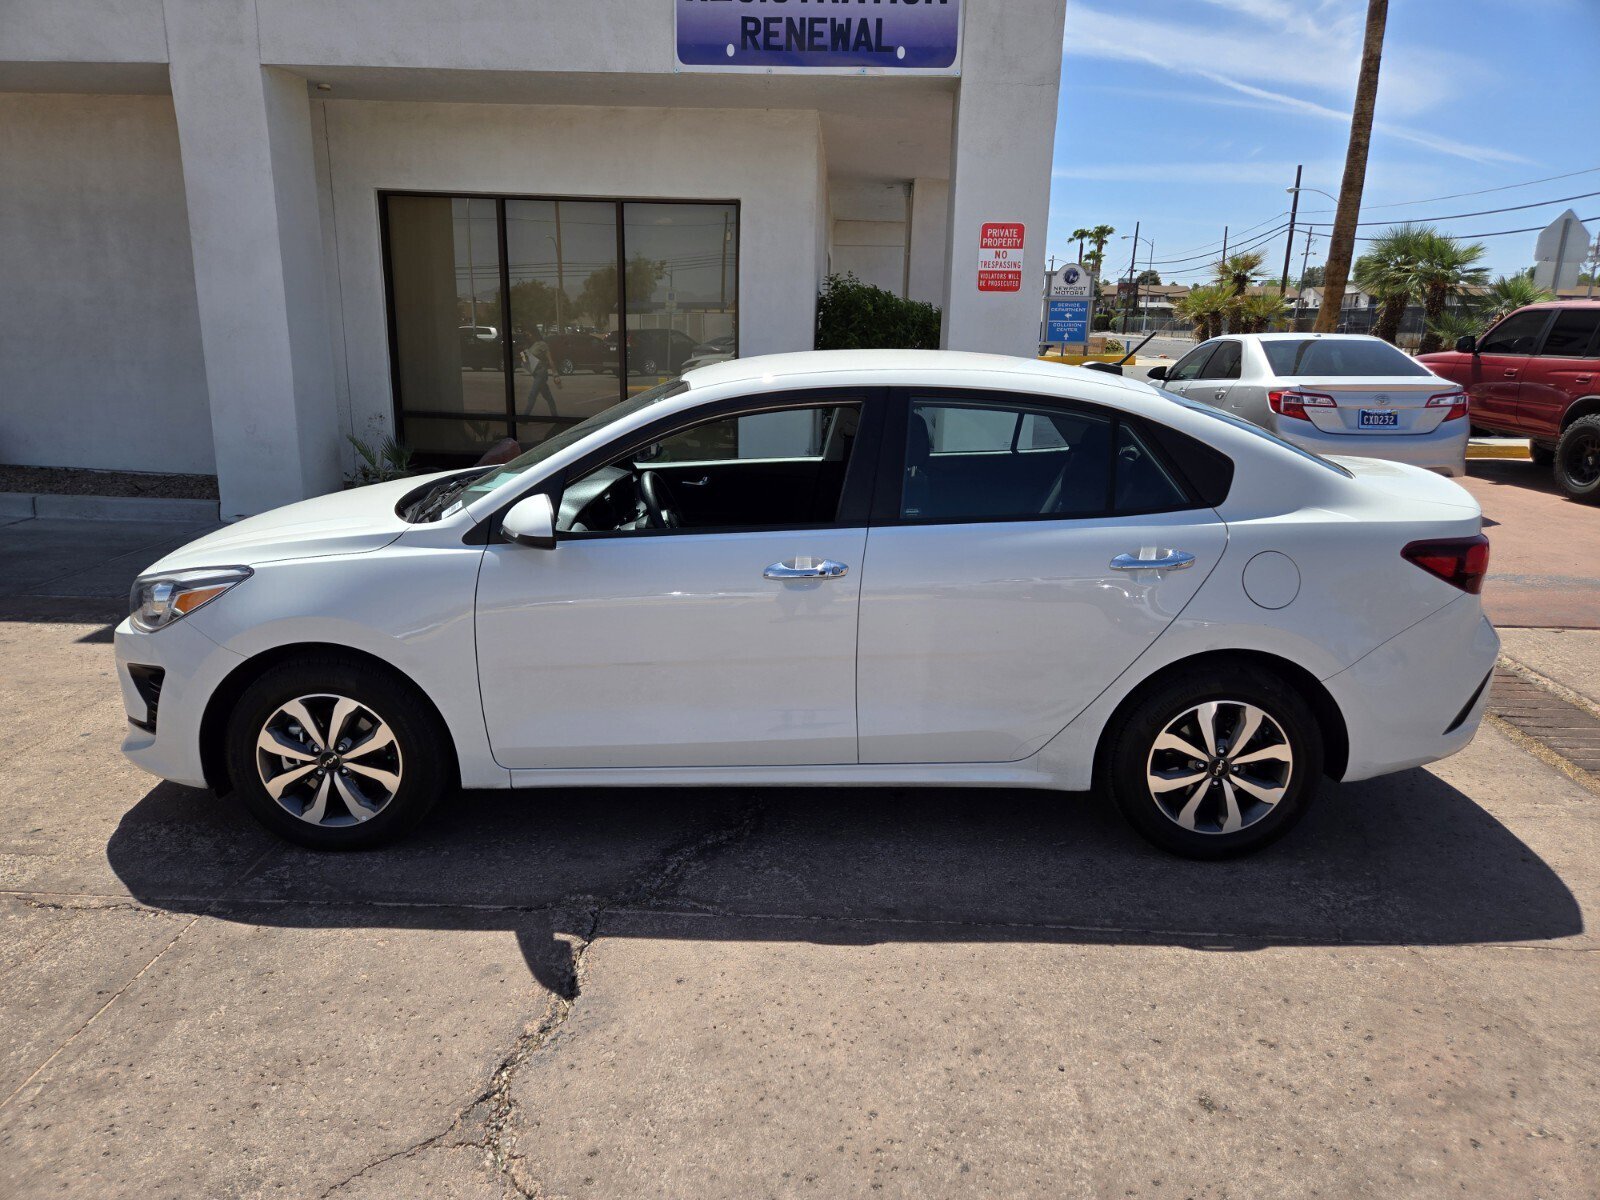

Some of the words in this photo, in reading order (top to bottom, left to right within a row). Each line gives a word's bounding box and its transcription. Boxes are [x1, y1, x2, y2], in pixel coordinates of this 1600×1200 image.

[740, 15, 895, 53] RENEWAL
[987, 228, 1018, 238] PRIVATE
[982, 237, 1022, 247] PROPERTY
[994, 250, 1008, 259] NO
[980, 261, 1022, 269] TRESPASSING
[1363, 415, 1394, 425] CXD232
